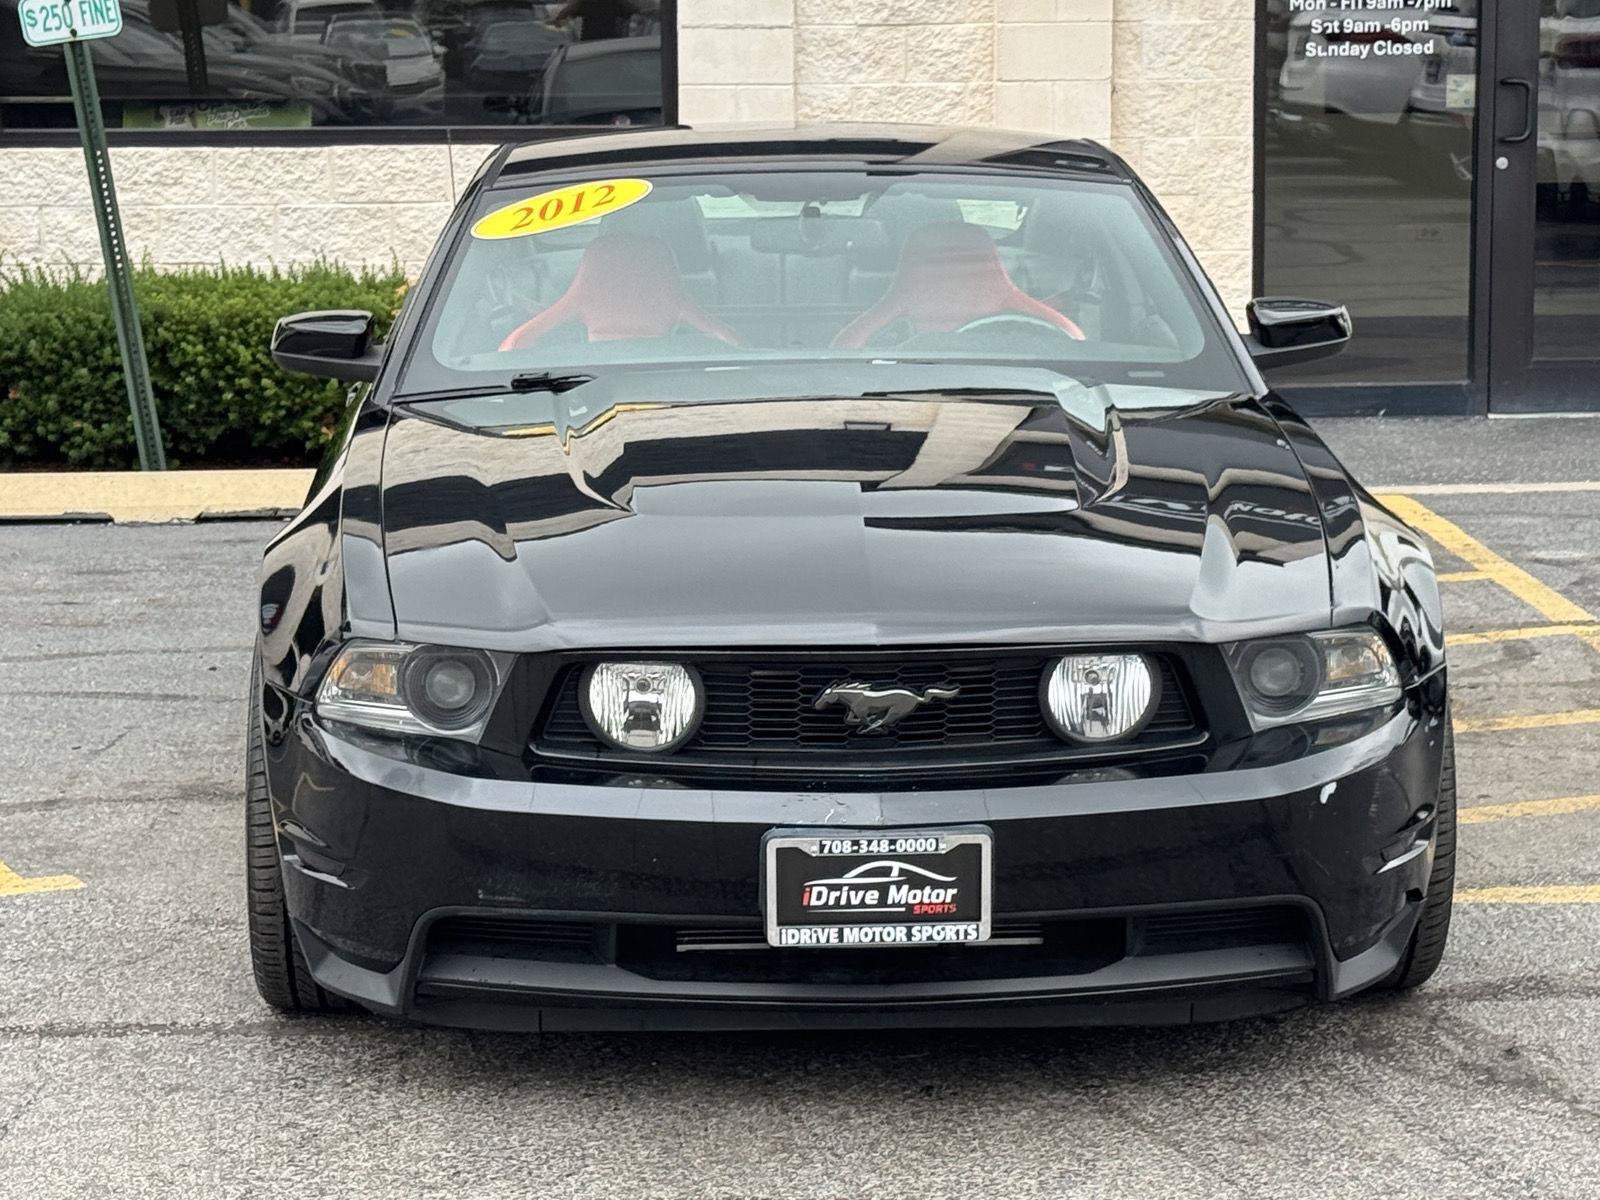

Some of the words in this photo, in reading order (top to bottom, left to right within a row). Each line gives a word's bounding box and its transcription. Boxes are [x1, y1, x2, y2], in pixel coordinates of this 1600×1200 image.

[79, 0, 116, 26] FINE
[1289, 0, 1326, 11] Mon
[1341, 0, 1362, 10] Fri
[1366, 0, 1404, 10] 9am
[1343, 19, 1381, 32] 9am
[1305, 41, 1370, 59] Sunday
[1373, 39, 1434, 55] Closed
[510, 184, 616, 231] 2012
[821, 838, 937, 854] 708-348-0000
[802, 885, 879, 906] iDrive
[887, 885, 958, 904] Motor
[913, 904, 957, 914] SPORTS
[843, 926, 907, 942] MOTOR
[911, 924, 978, 941] SPORTS
